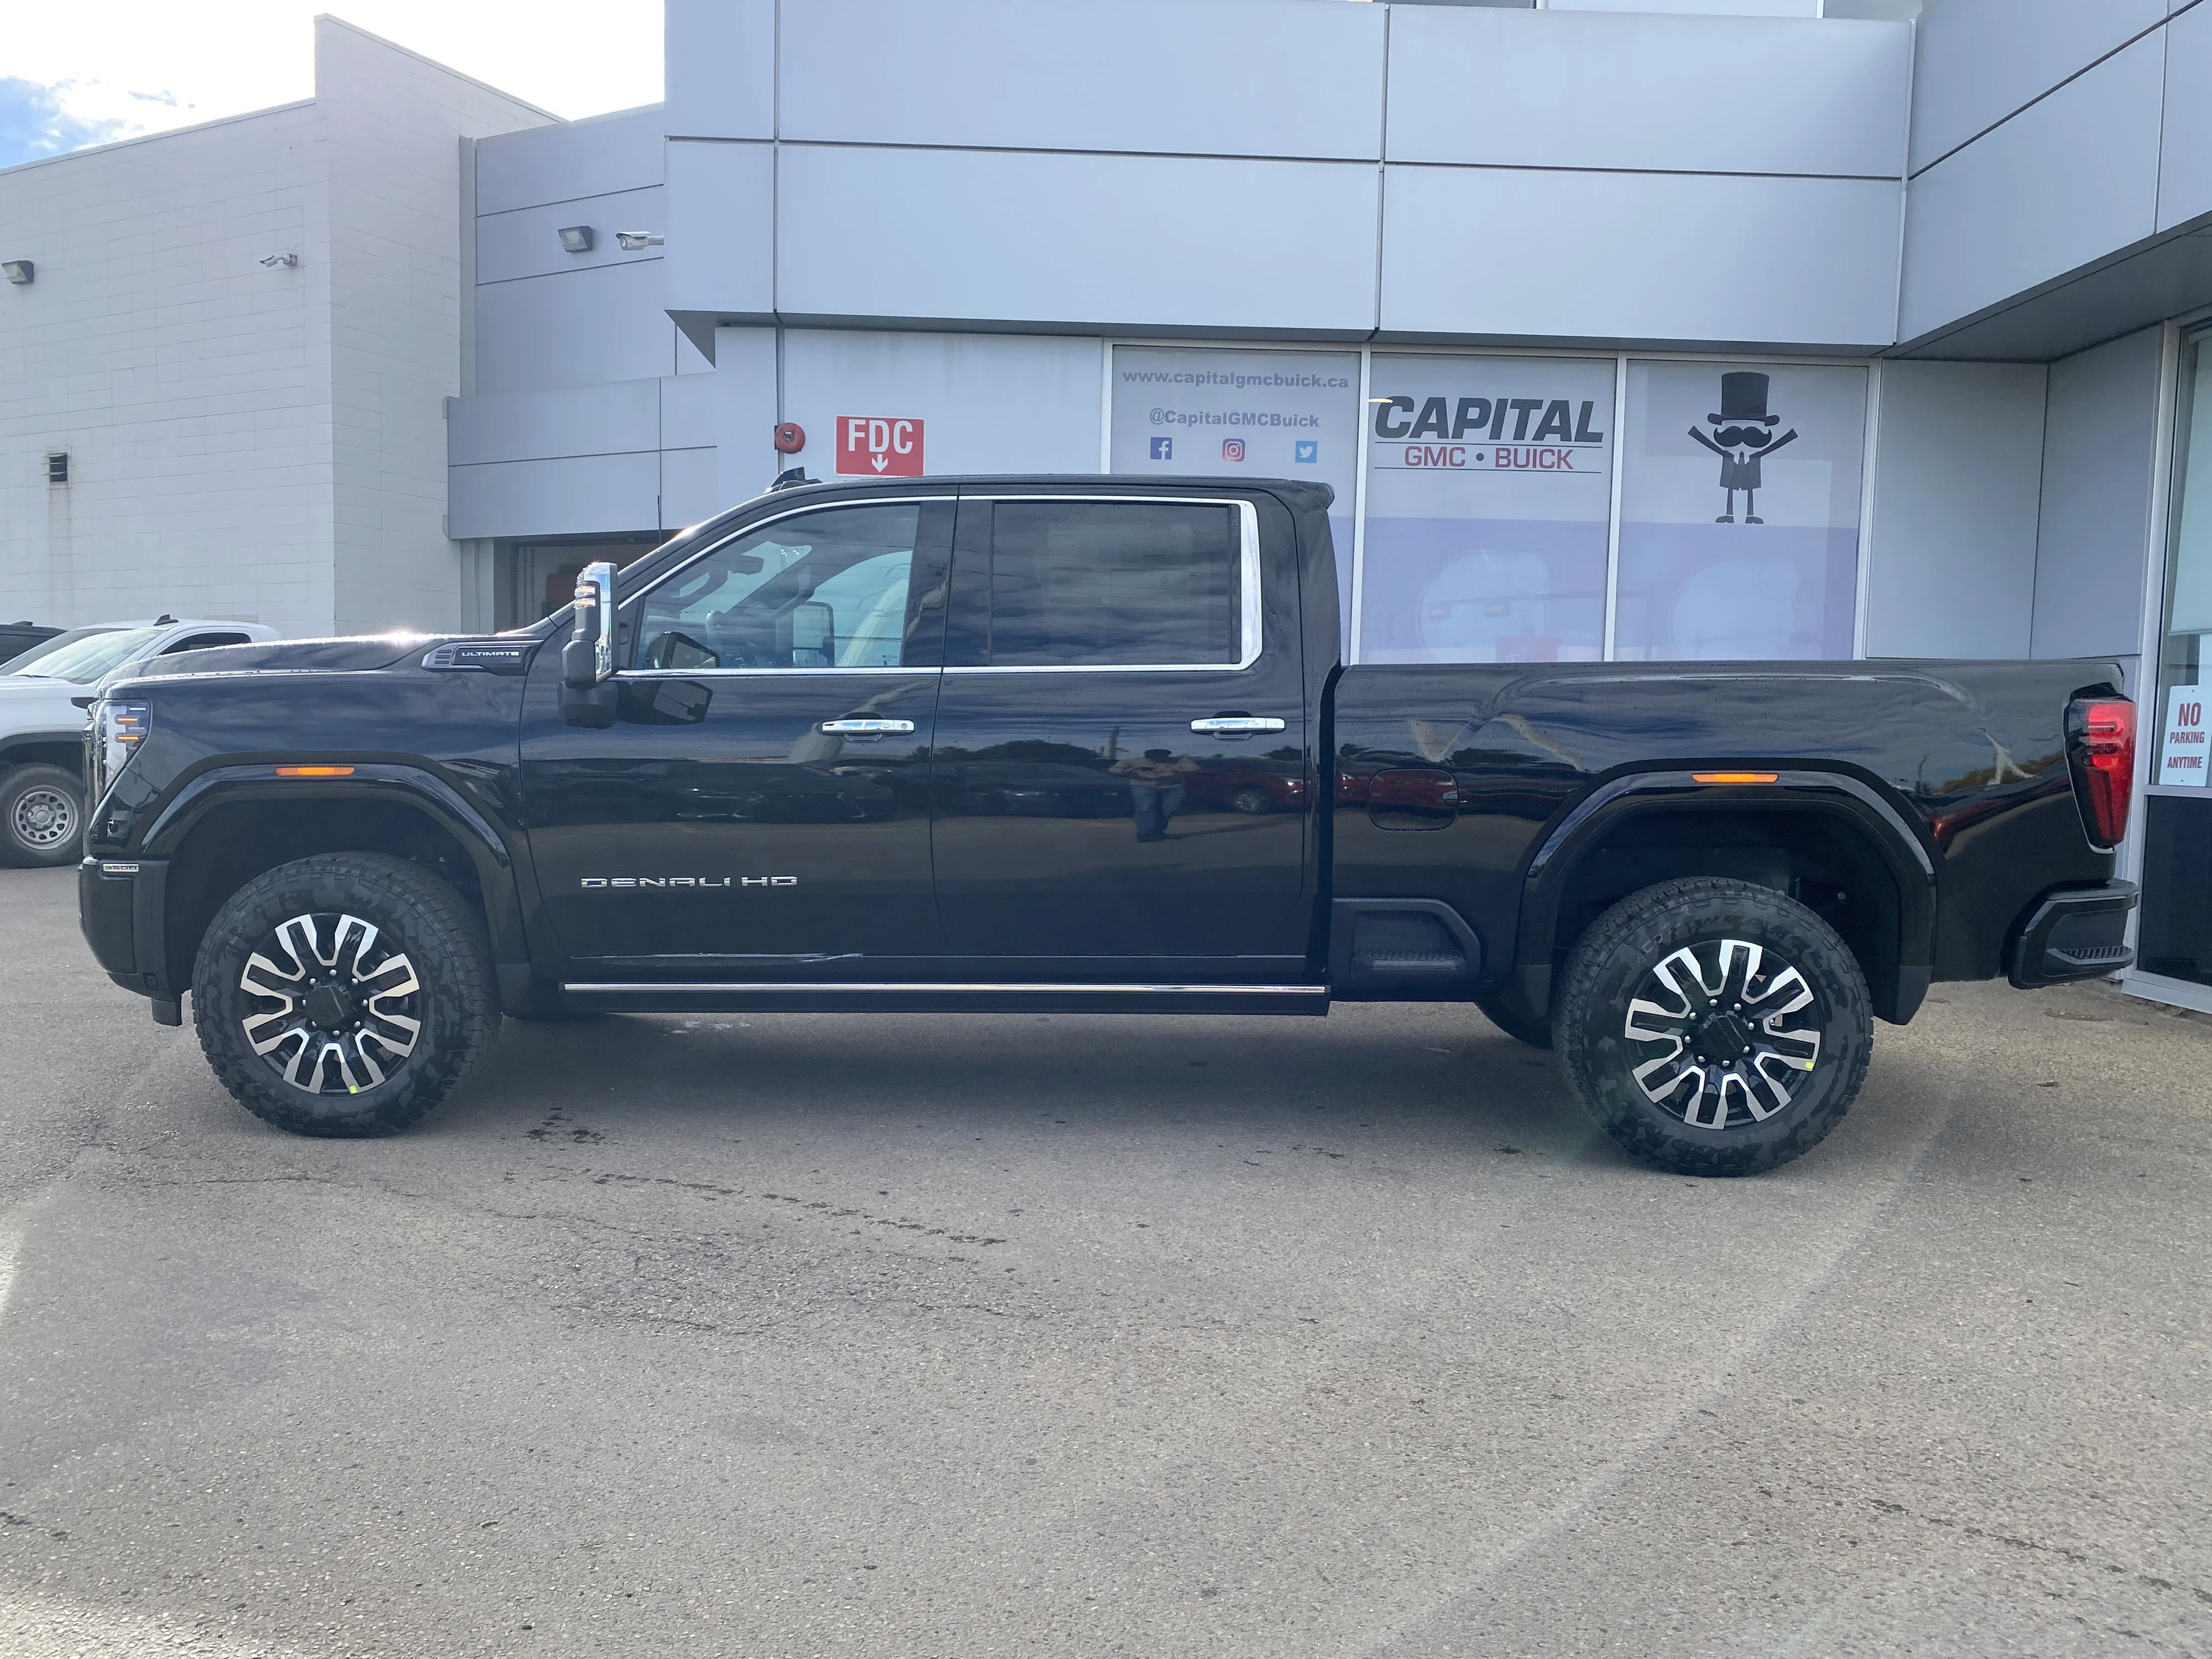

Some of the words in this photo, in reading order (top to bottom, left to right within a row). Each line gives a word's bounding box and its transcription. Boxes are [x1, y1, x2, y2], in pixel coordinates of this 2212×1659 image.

[1123, 371, 1348, 388] www.capitalgmcbuick.ca
[1150, 408, 1319, 427] @CapitalGMCBuick
[1375, 396, 1604, 442] CAPITAL
[848, 419, 913, 454] FDC
[1405, 446, 1465, 467] GMC
[1495, 448, 1573, 469] BUICK
[2178, 702, 2202, 726] NO
[2170, 731, 2205, 744] PARKING
[2167, 757, 2203, 769] ANYTIME
[581, 877, 730, 888] DENALI
[742, 876, 798, 887] HD
